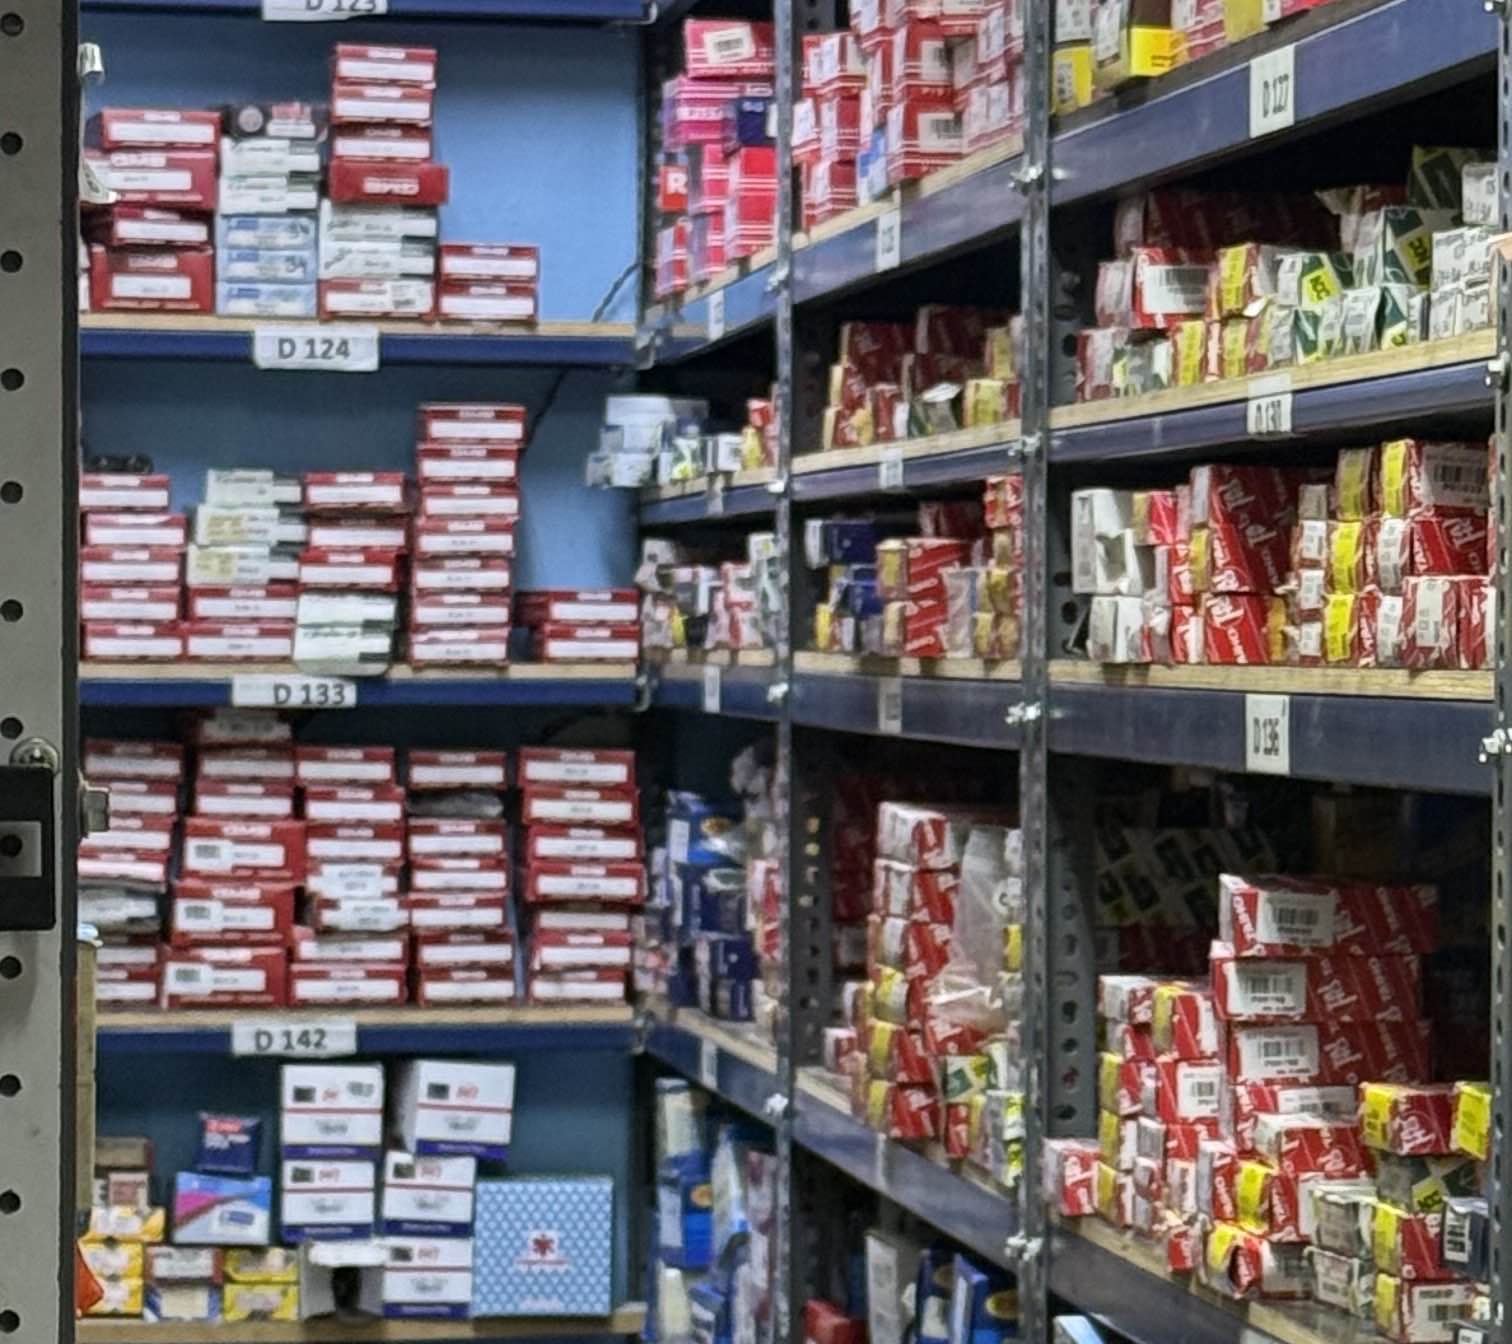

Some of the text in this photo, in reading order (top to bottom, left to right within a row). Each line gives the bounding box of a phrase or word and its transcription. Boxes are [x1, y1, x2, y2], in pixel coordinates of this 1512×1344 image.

[1262, 80, 1269, 118] D
[278, 337, 351, 359] D 124
[274, 683, 346, 706] D 133
[1252, 717, 1261, 755] D
[255, 1028, 327, 1051] D 142
